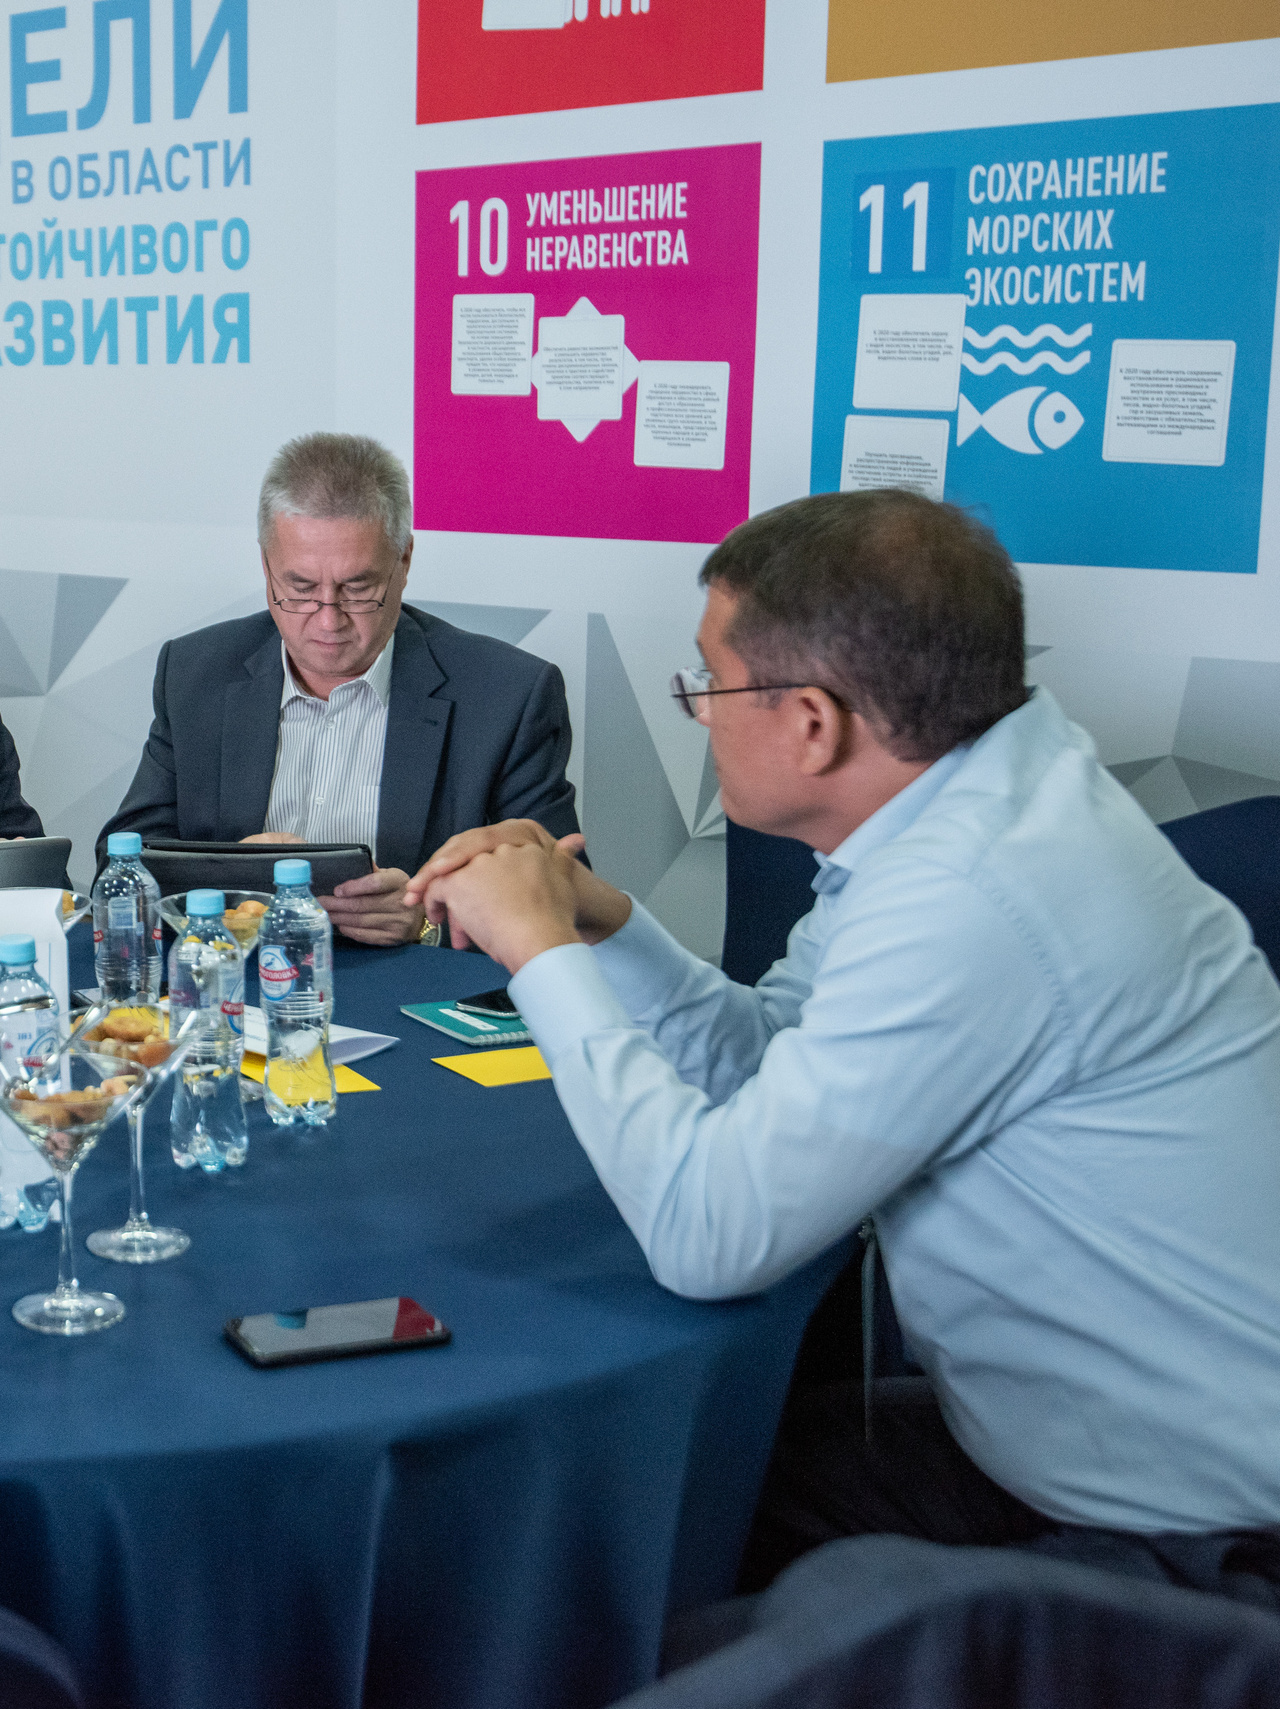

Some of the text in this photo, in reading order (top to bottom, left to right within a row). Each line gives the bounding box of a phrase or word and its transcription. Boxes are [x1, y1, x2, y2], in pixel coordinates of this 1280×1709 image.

[11, 137, 251, 204] В ОБЛАСТИ
[968, 152, 1168, 204] СОХРАНЕНИЕ
[526, 182, 688, 227] УМЕНЬШЕНИЕ
[859, 181, 929, 274] 11
[449, 197, 508, 277] 10
[526, 229, 689, 272] НЕРАВЕНСТВА
[967, 209, 1115, 256] МОРСКИХ
[965, 261, 1146, 307] ЭКОСИСТЕМ
